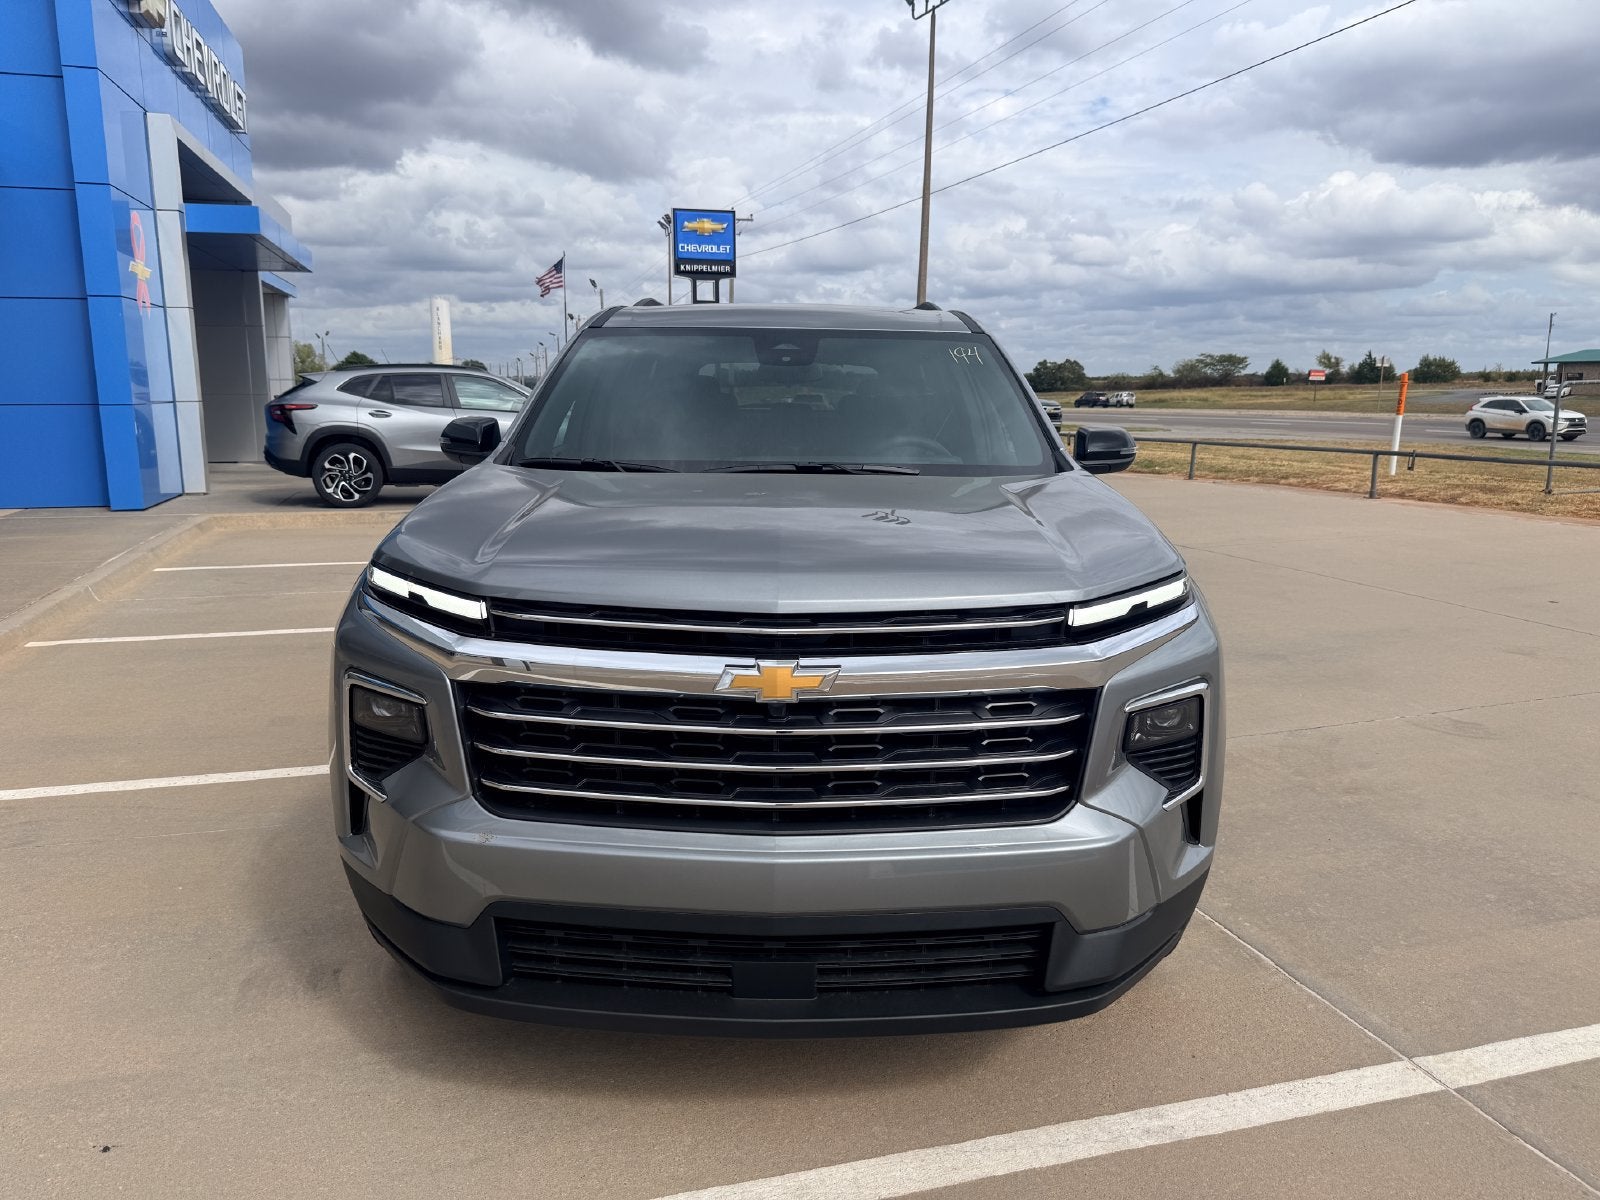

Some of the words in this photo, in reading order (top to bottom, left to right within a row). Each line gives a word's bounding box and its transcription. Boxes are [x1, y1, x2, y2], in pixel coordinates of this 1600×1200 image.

[165, 0, 247, 133] CHEVROLET
[678, 243, 731, 253] CHEVROLET
[680, 264, 731, 272] KNIPPELMIER
[948, 346, 984, 365] 194
